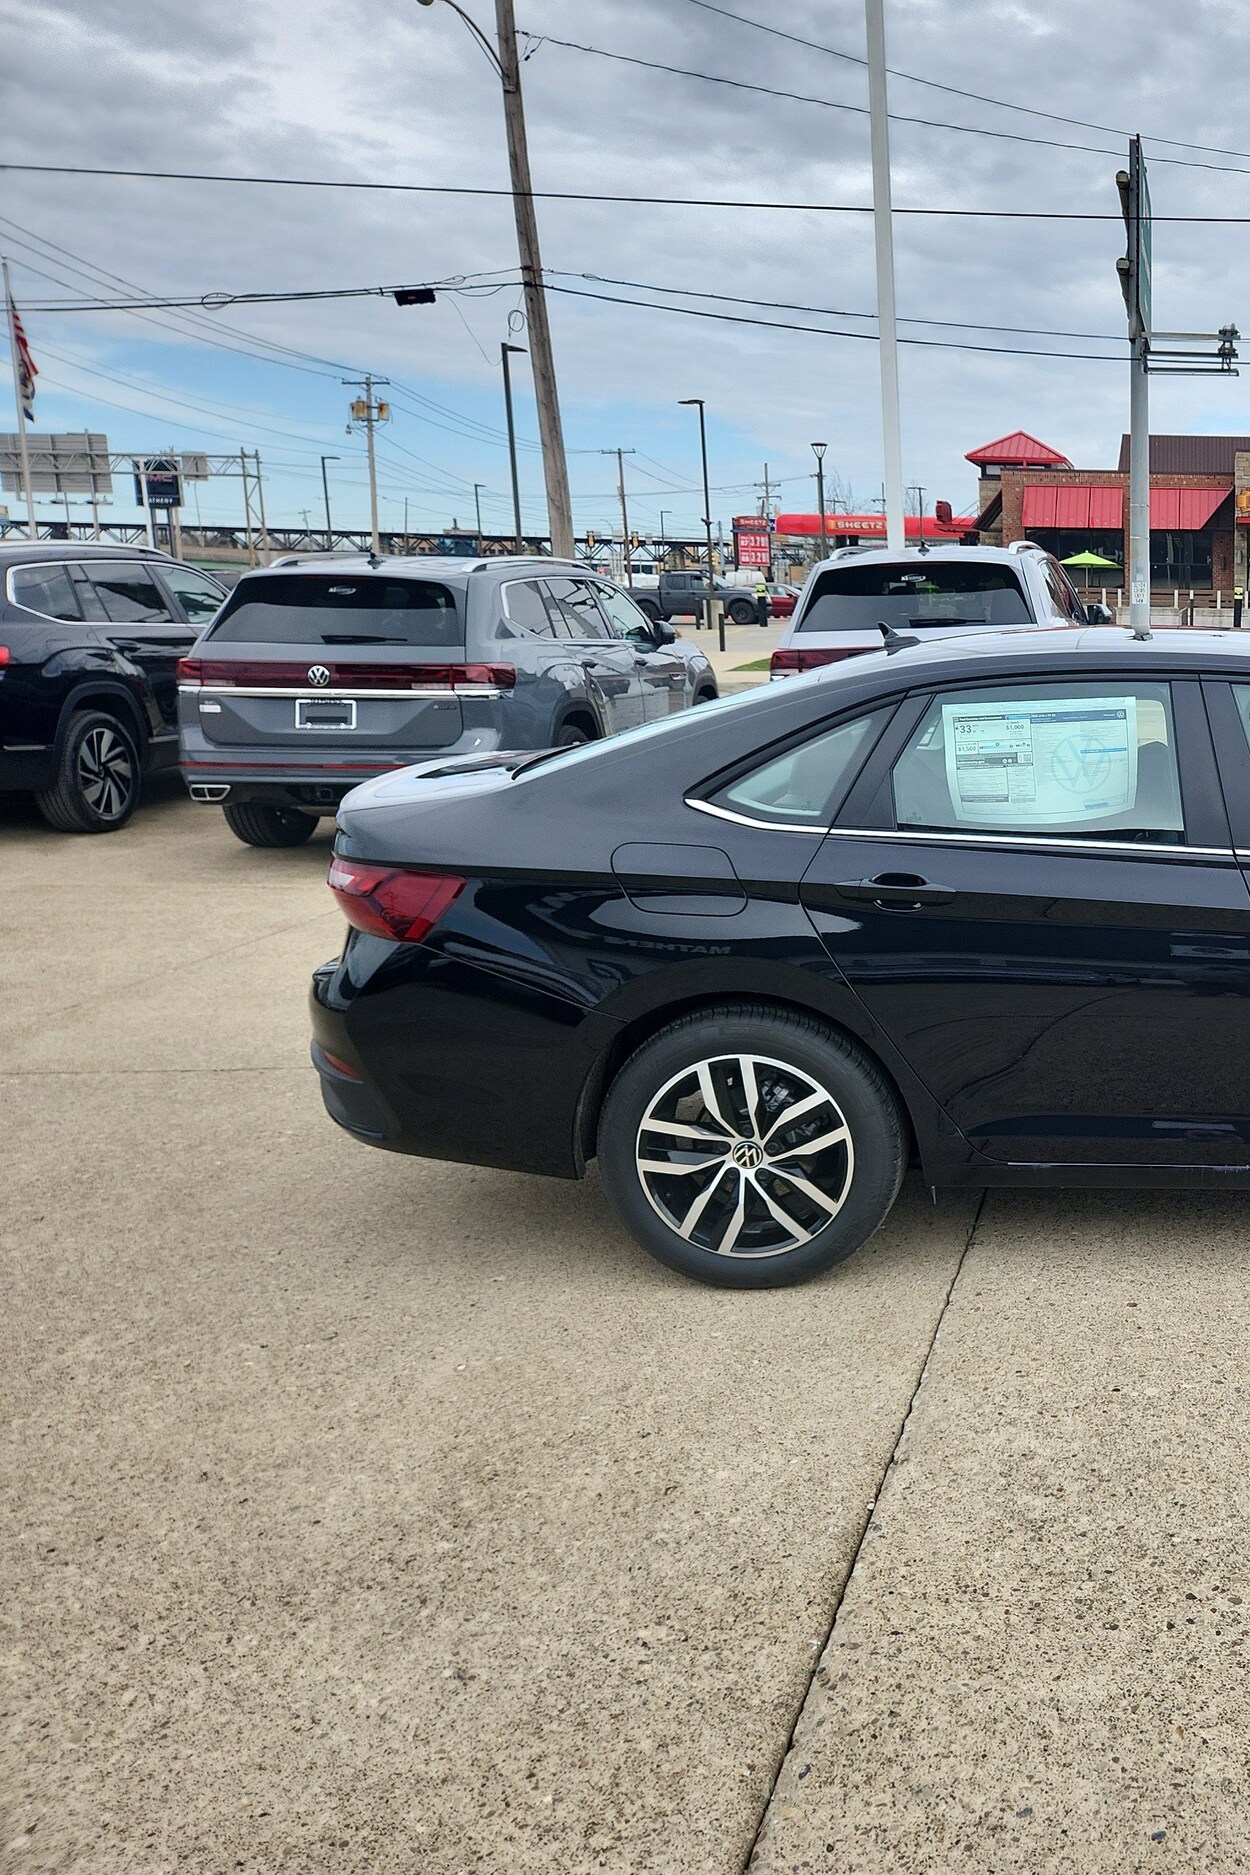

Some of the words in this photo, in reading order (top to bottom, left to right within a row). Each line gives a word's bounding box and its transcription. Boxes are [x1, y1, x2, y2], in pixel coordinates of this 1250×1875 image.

[739, 518, 767, 526] SHEETZ
[837, 521, 883, 529] SHEETZ
[959, 724, 972, 734] 33
